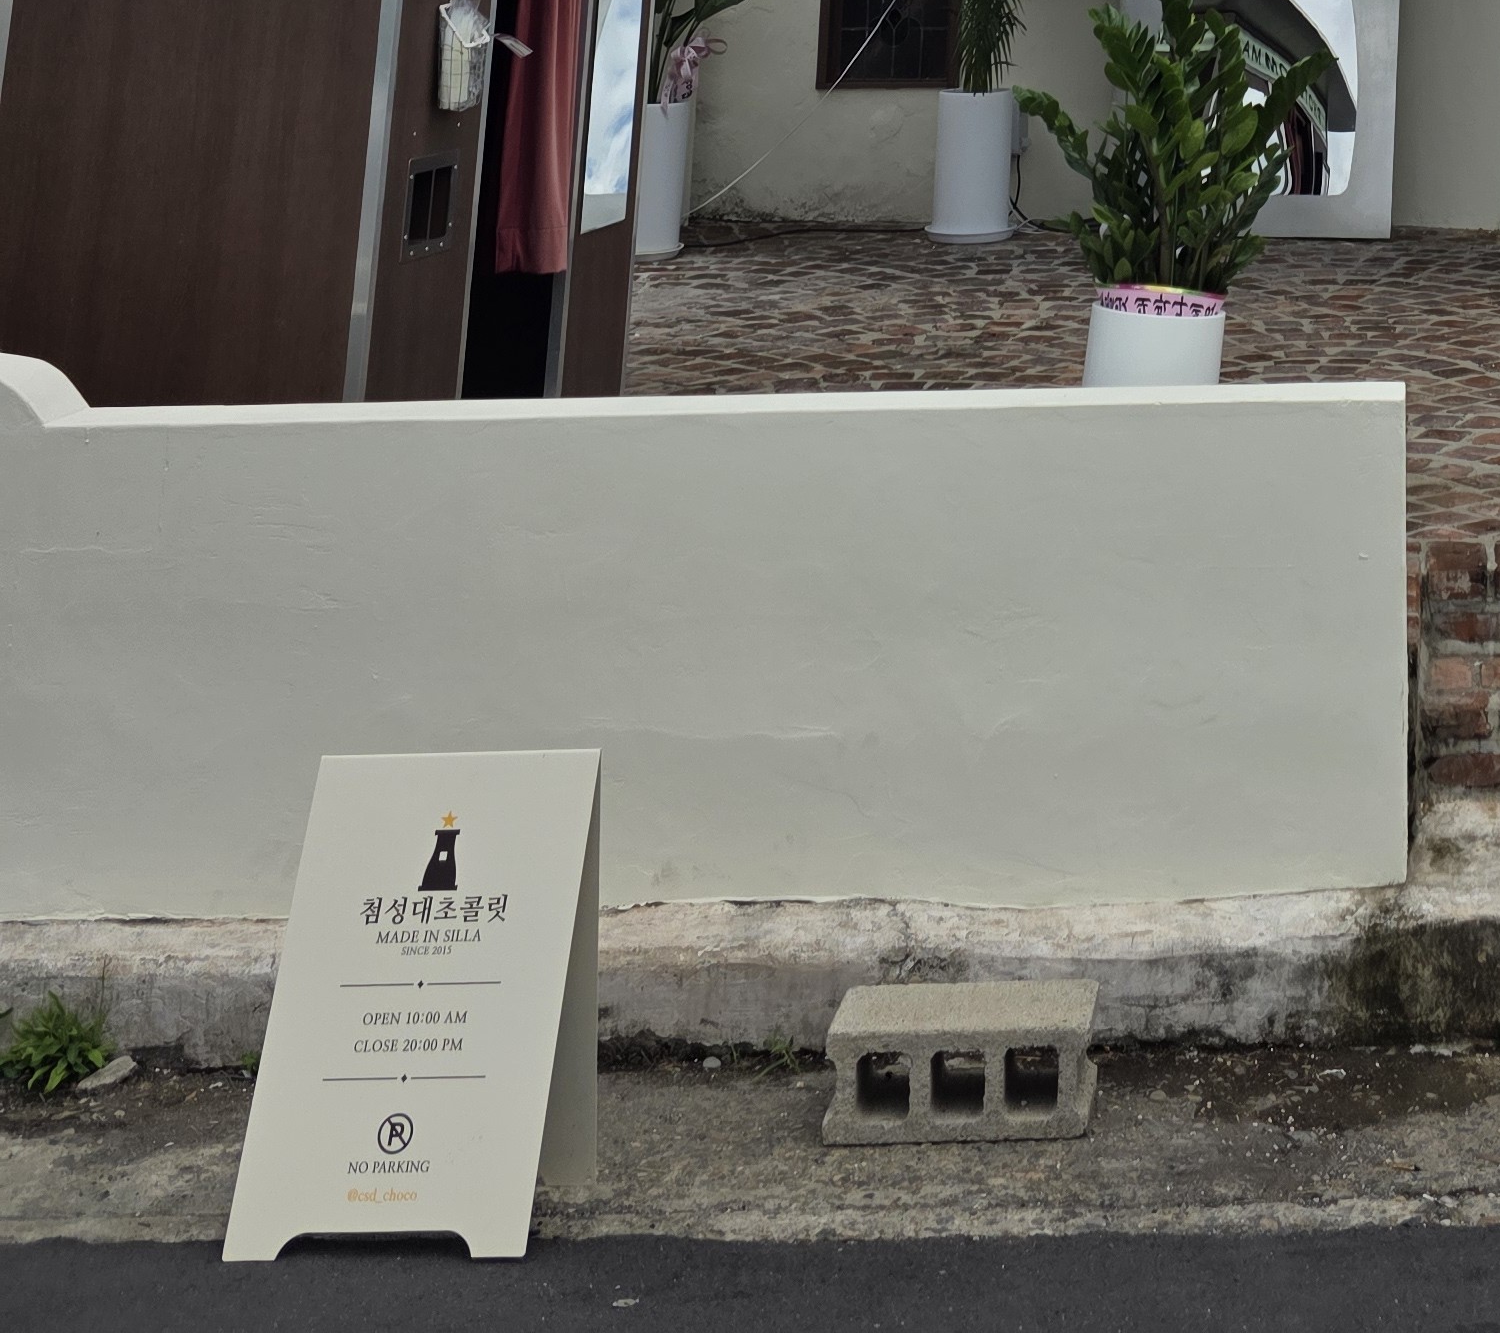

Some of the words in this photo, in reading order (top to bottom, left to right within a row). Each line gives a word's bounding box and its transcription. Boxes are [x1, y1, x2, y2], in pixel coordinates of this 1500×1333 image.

[360, 893, 508, 926] 첨성대초콜릿
[375, 929, 420, 944] MADE
[422, 929, 440, 943] IN
[443, 928, 481, 942] SILLA
[401, 946, 430, 956] SINCE
[432, 945, 453, 955] 2015
[362, 1011, 402, 1025] OPEN
[405, 1011, 441, 1025] 10:00
[444, 1010, 468, 1024] AM
[354, 1038, 399, 1053] CLOSE
[402, 1038, 438, 1052] 20:00
[441, 1037, 464, 1051] PM
[347, 1161, 369, 1175] NO
[372, 1160, 430, 1174] PARKING
[347, 1187, 418, 1204] @csd_choco
